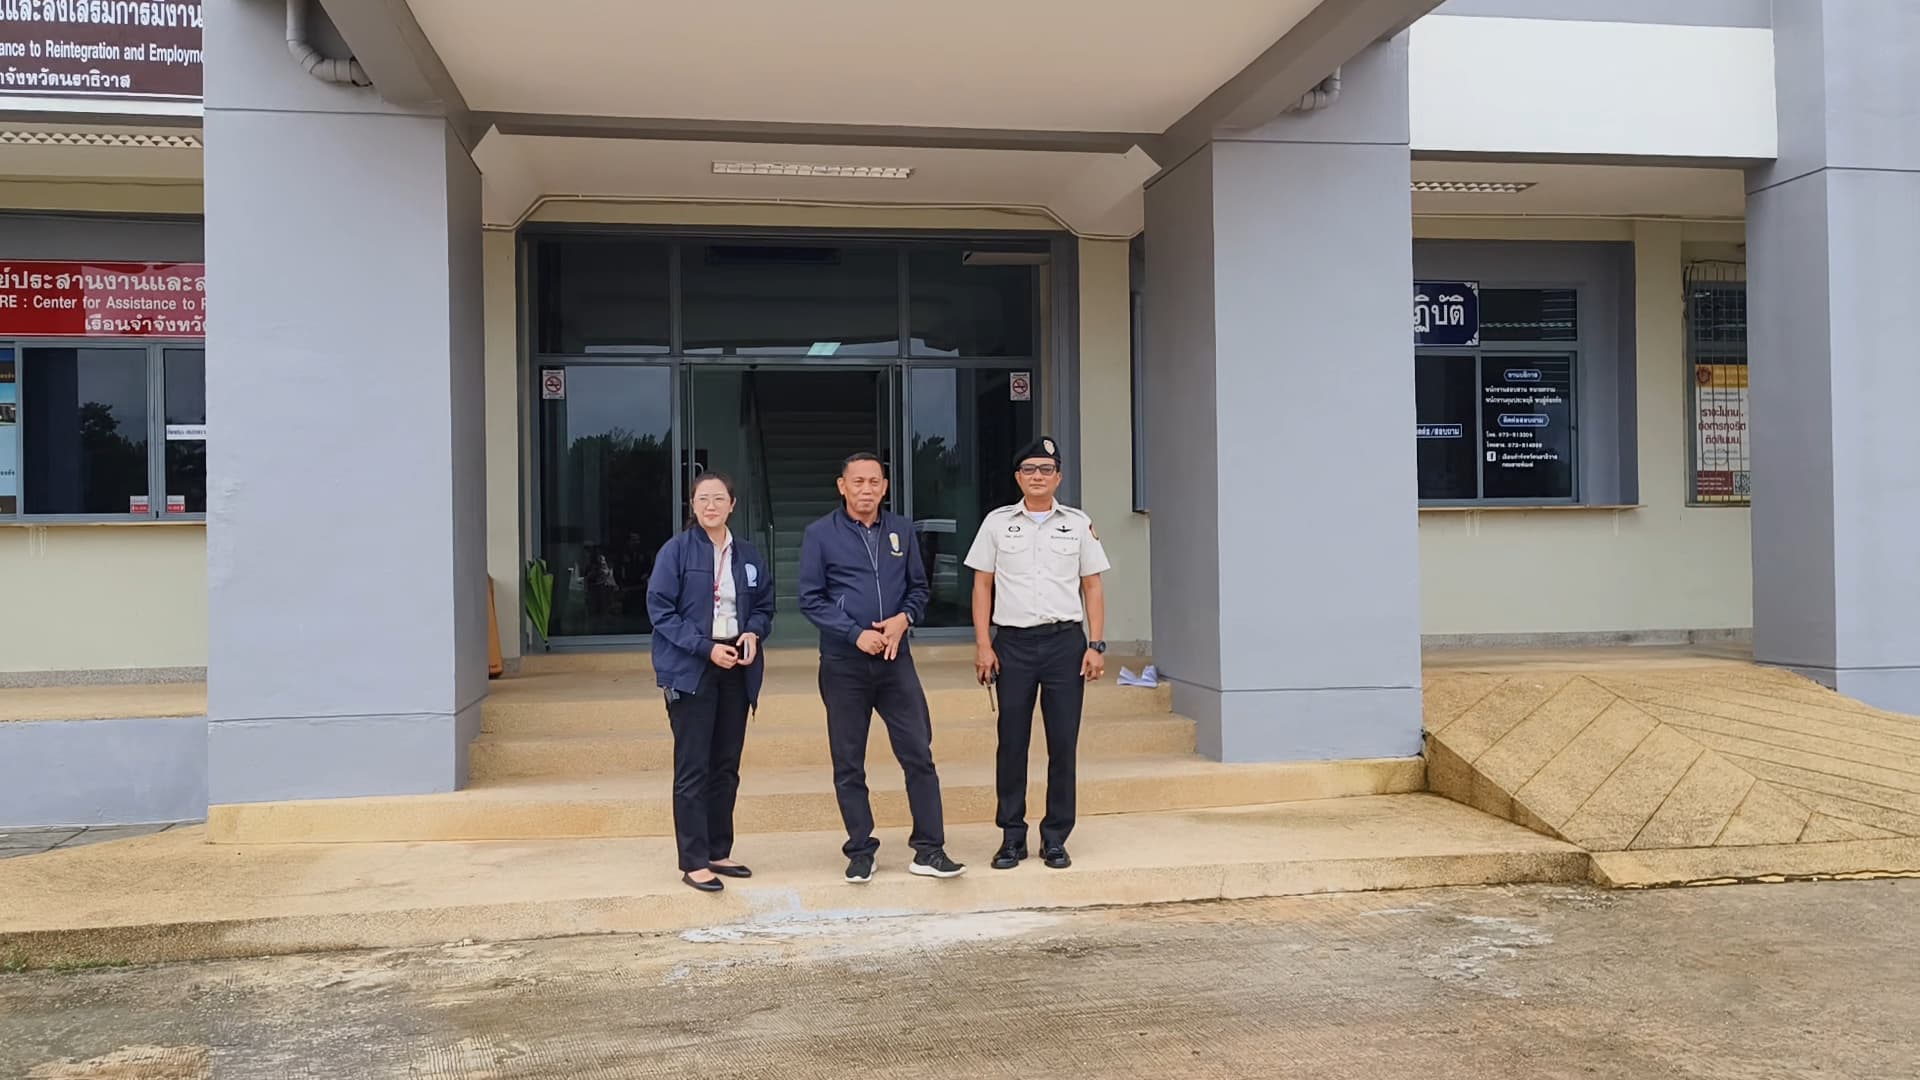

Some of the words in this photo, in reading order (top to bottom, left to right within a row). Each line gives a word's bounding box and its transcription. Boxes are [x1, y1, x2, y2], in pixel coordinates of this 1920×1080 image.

[29, 40, 41, 57] to
[46, 40, 120, 62] Reintegration
[124, 43, 145, 61] and
[33, 295, 78, 309] Center
[83, 296, 101, 310] for
[106, 296, 177, 310] Assistance
[182, 297, 196, 310] to
[85, 313, 206, 332] เรือนจำจังหวั
